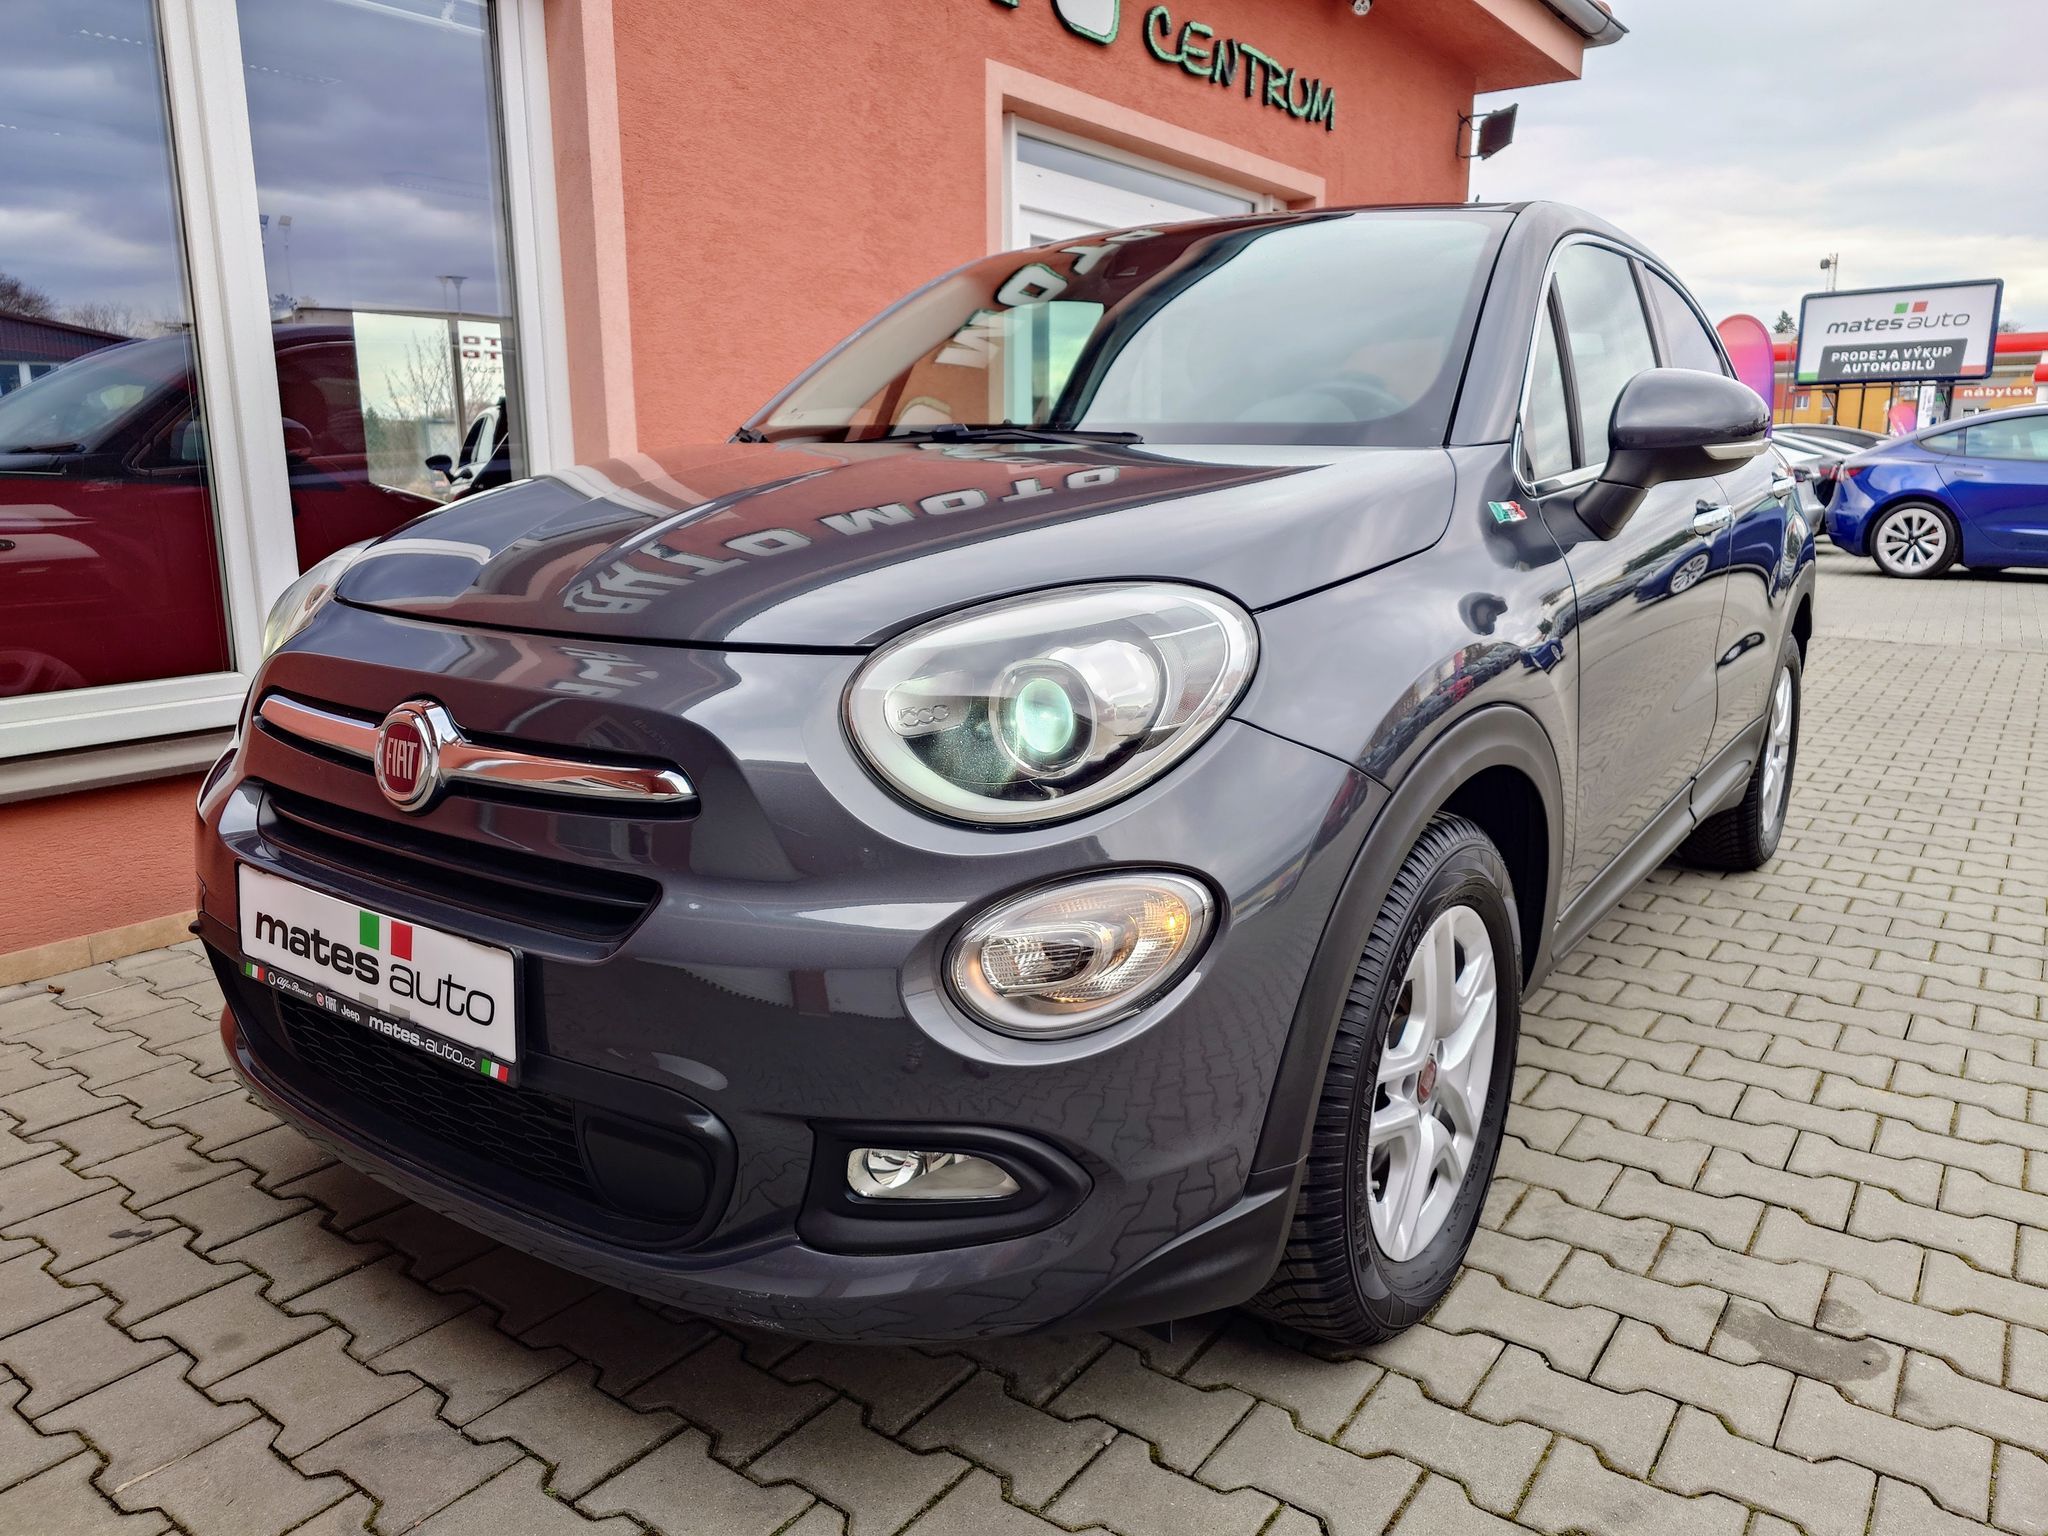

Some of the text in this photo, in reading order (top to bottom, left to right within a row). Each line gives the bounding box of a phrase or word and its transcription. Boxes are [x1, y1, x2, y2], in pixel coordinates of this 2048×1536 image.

[1143, 5, 1335, 132] CENTRUM
[1826, 313, 1970, 334] mates auto
[1831, 345, 1953, 363] PRODEJ A VÝKUP
[1842, 357, 1936, 374] AUTOMOBILŮ
[386, 737, 418, 780] FIAT
[255, 911, 495, 1026] mates auto
[276, 977, 476, 1070] Alfa Romeo FIAT Jeep mates-auto.cz
